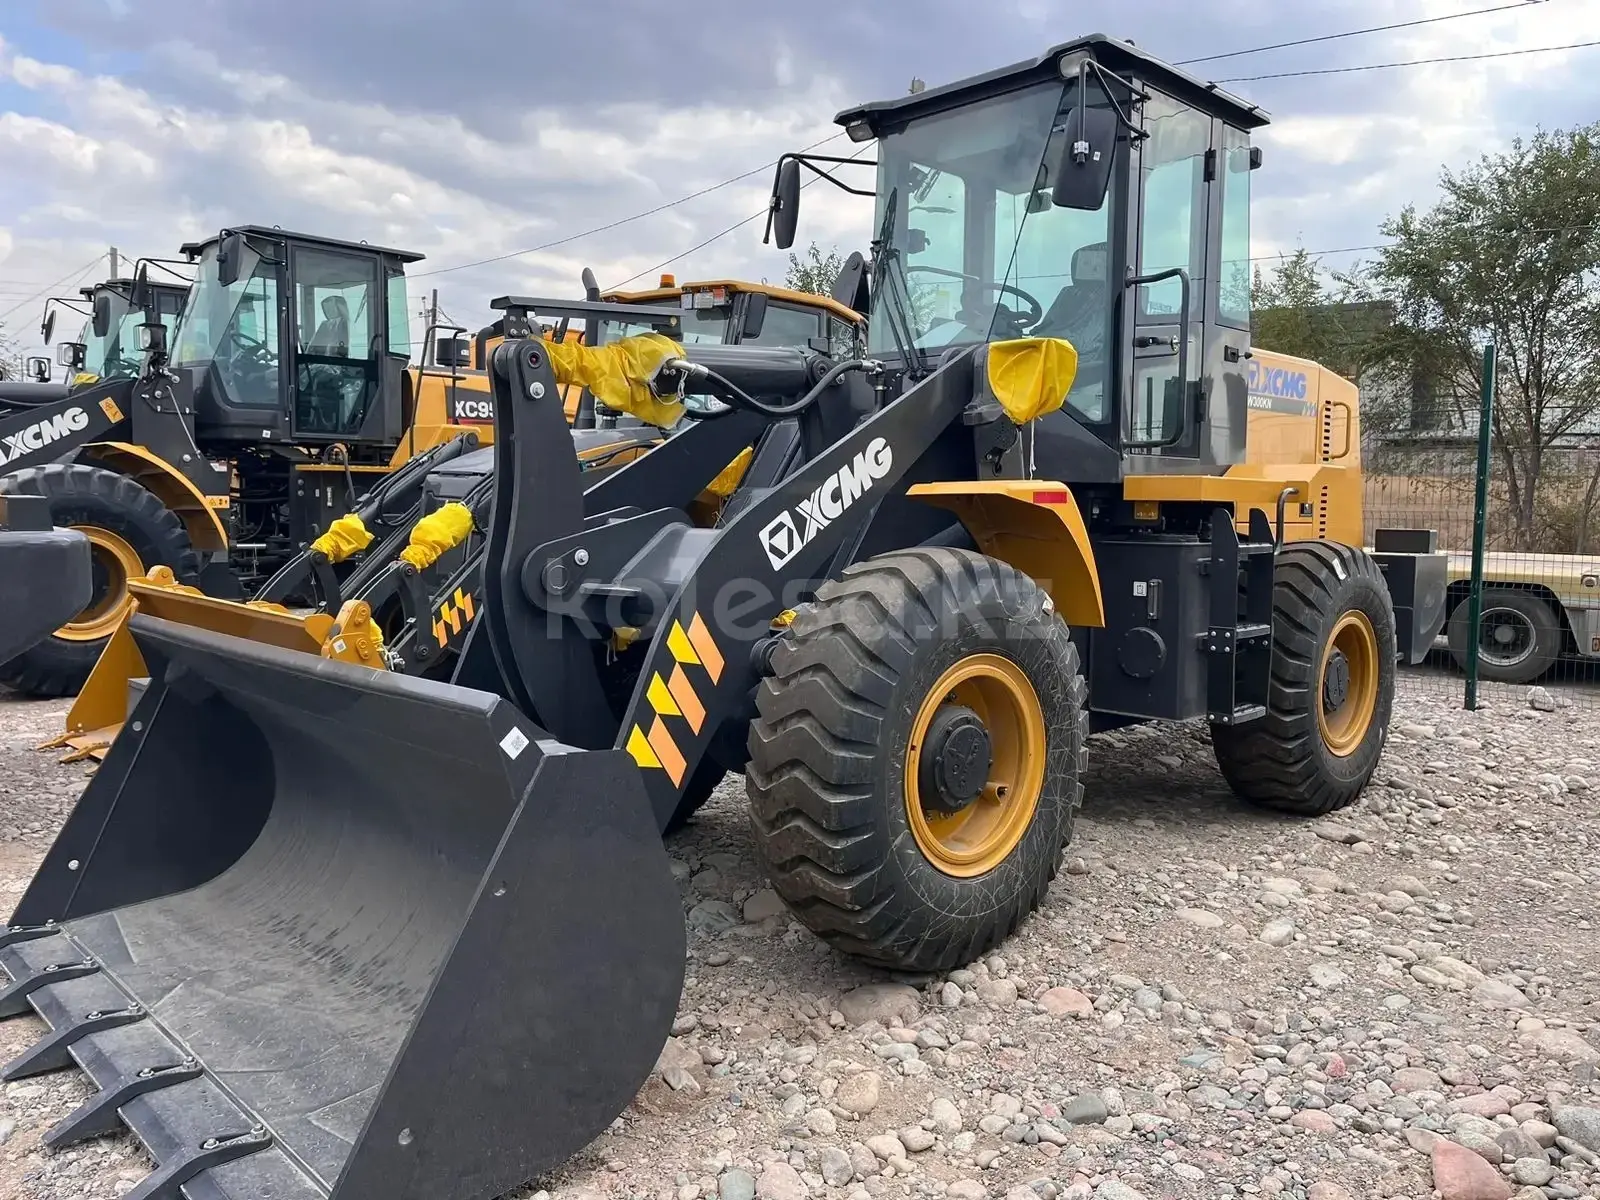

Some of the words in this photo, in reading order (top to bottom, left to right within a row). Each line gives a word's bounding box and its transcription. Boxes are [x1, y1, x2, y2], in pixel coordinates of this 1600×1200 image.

[1261, 367, 1307, 399] XCMG
[2, 407, 89, 463] XCMG
[795, 437, 893, 546] XCMG
